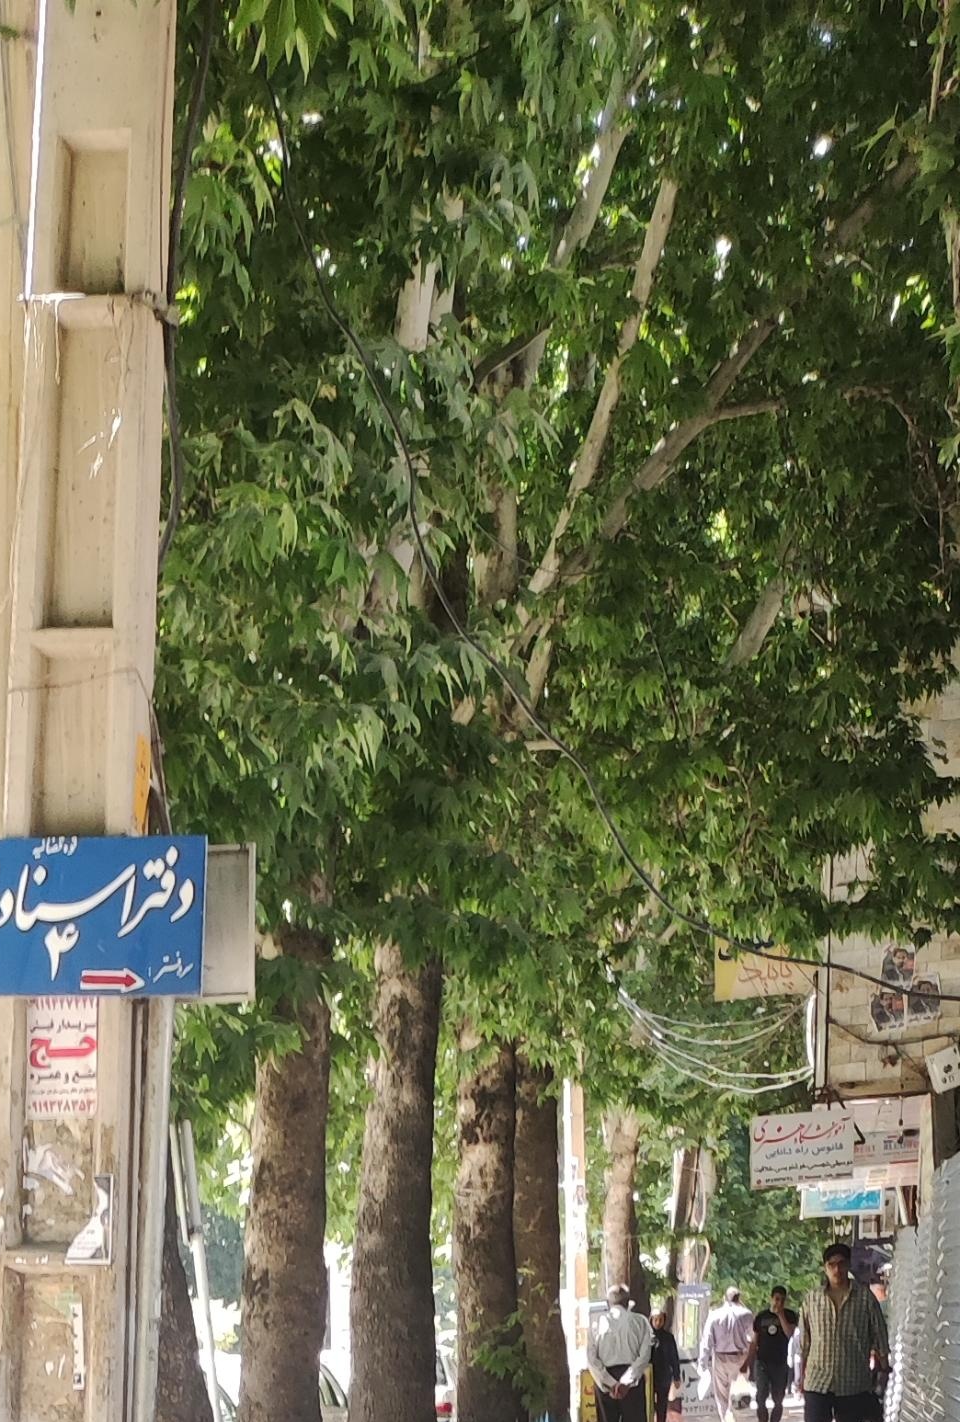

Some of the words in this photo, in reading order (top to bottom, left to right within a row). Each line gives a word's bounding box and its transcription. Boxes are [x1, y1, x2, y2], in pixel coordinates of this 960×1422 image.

[116, 845, 195, 938] دفتر
[44, 923, 80, 981] ۴
[29, 1036, 96, 1070] حج
